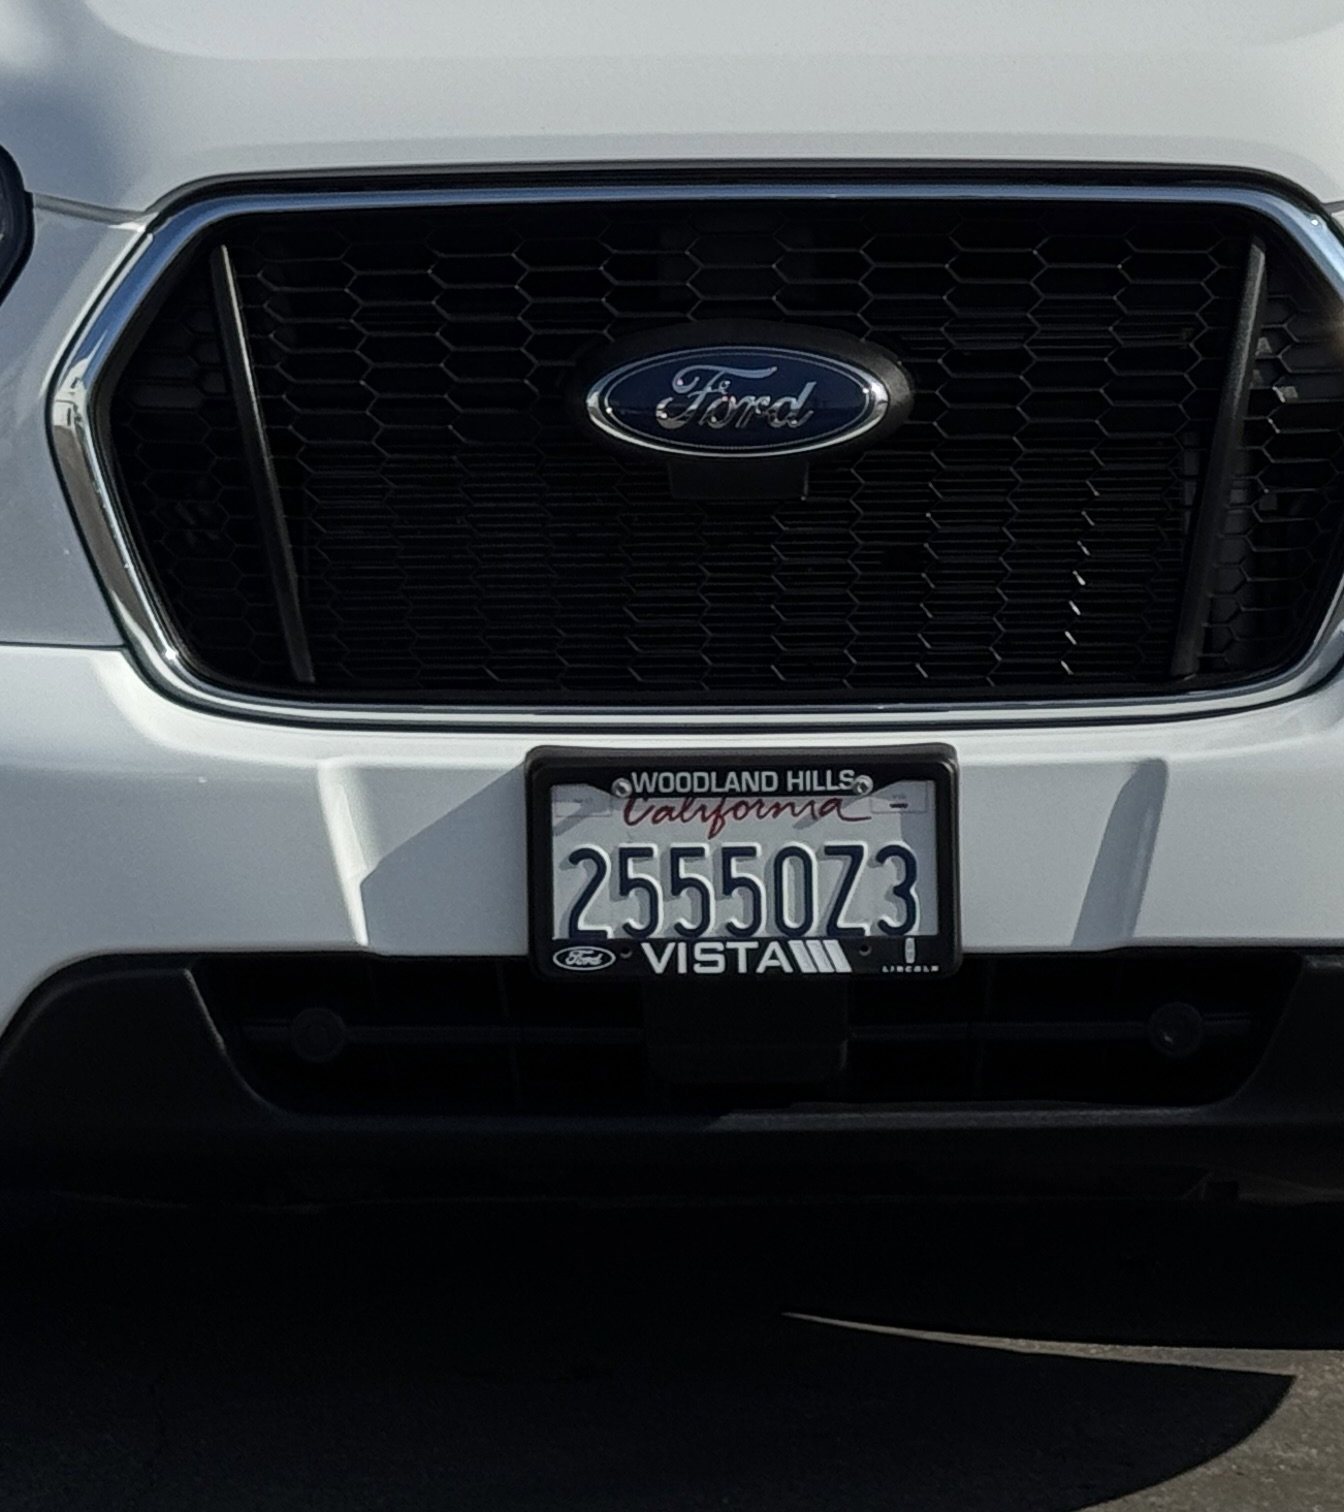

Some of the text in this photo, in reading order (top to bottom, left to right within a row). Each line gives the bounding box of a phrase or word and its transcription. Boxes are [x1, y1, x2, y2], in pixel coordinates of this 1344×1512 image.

[656, 364, 817, 429] Ford
[630, 770, 856, 794] WOODLAND HILLS
[622, 796, 872, 840] California
[568, 843, 918, 938] 25550Z3
[564, 949, 604, 966] Ford
[640, 941, 792, 974] VISTA
